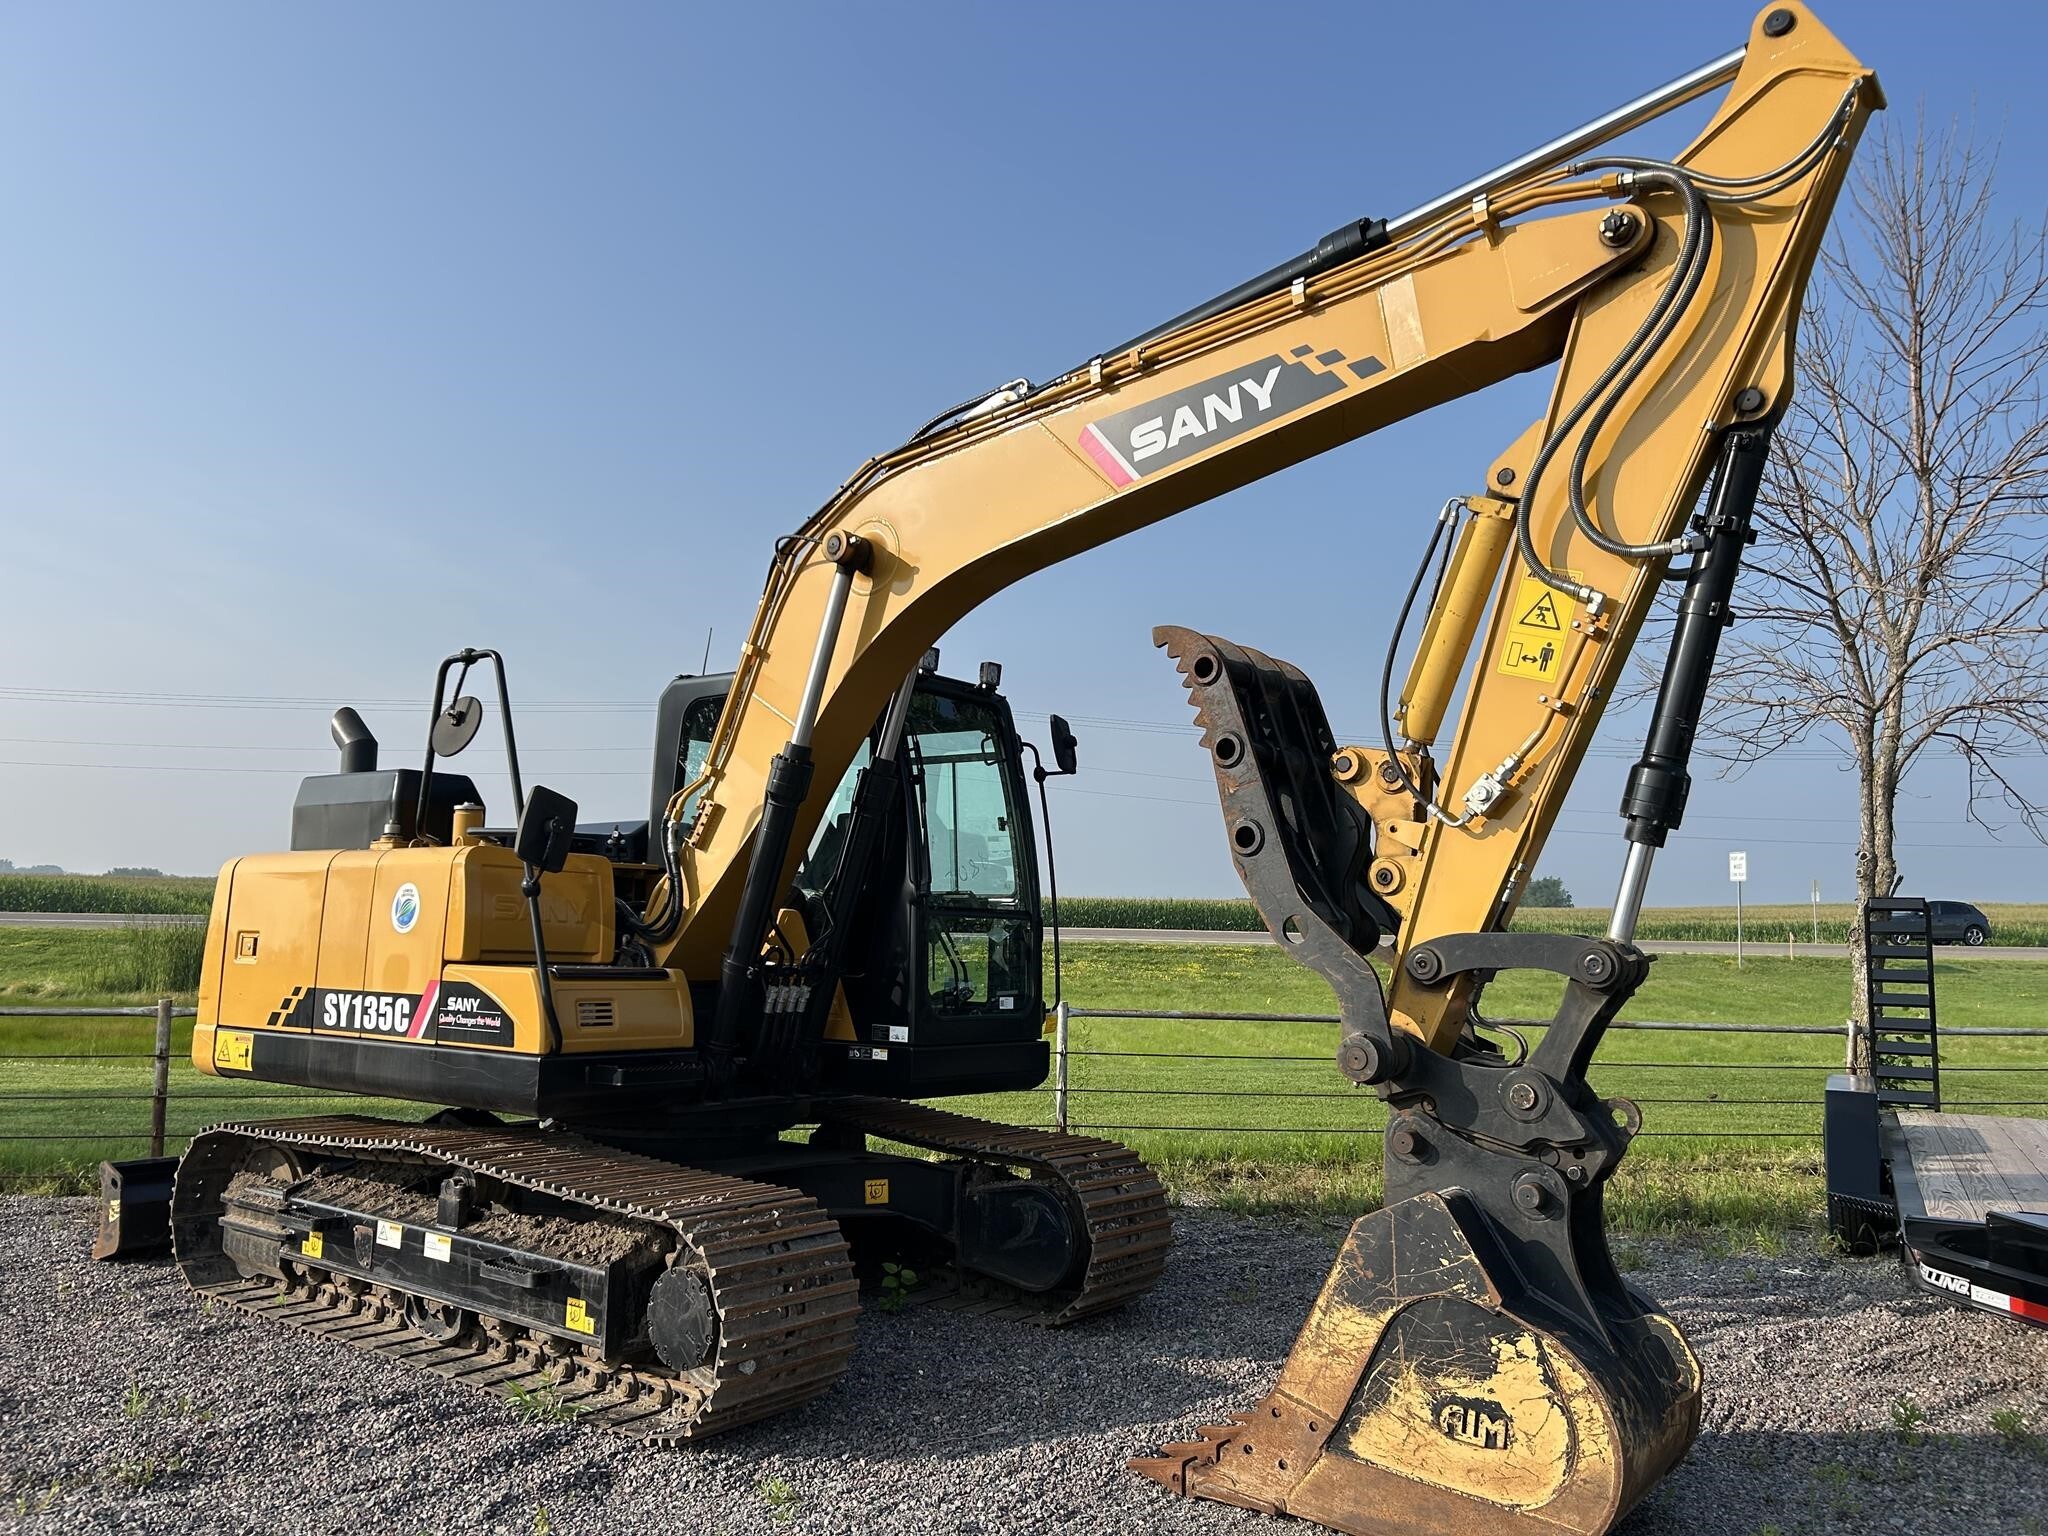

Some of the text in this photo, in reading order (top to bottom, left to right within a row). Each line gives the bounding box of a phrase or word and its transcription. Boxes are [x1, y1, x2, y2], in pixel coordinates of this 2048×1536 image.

[1129, 365, 1283, 463] SANY
[323, 992, 410, 1033] SY135C
[447, 996, 481, 1012] SANY
[438, 1013, 456, 1026] Quality
